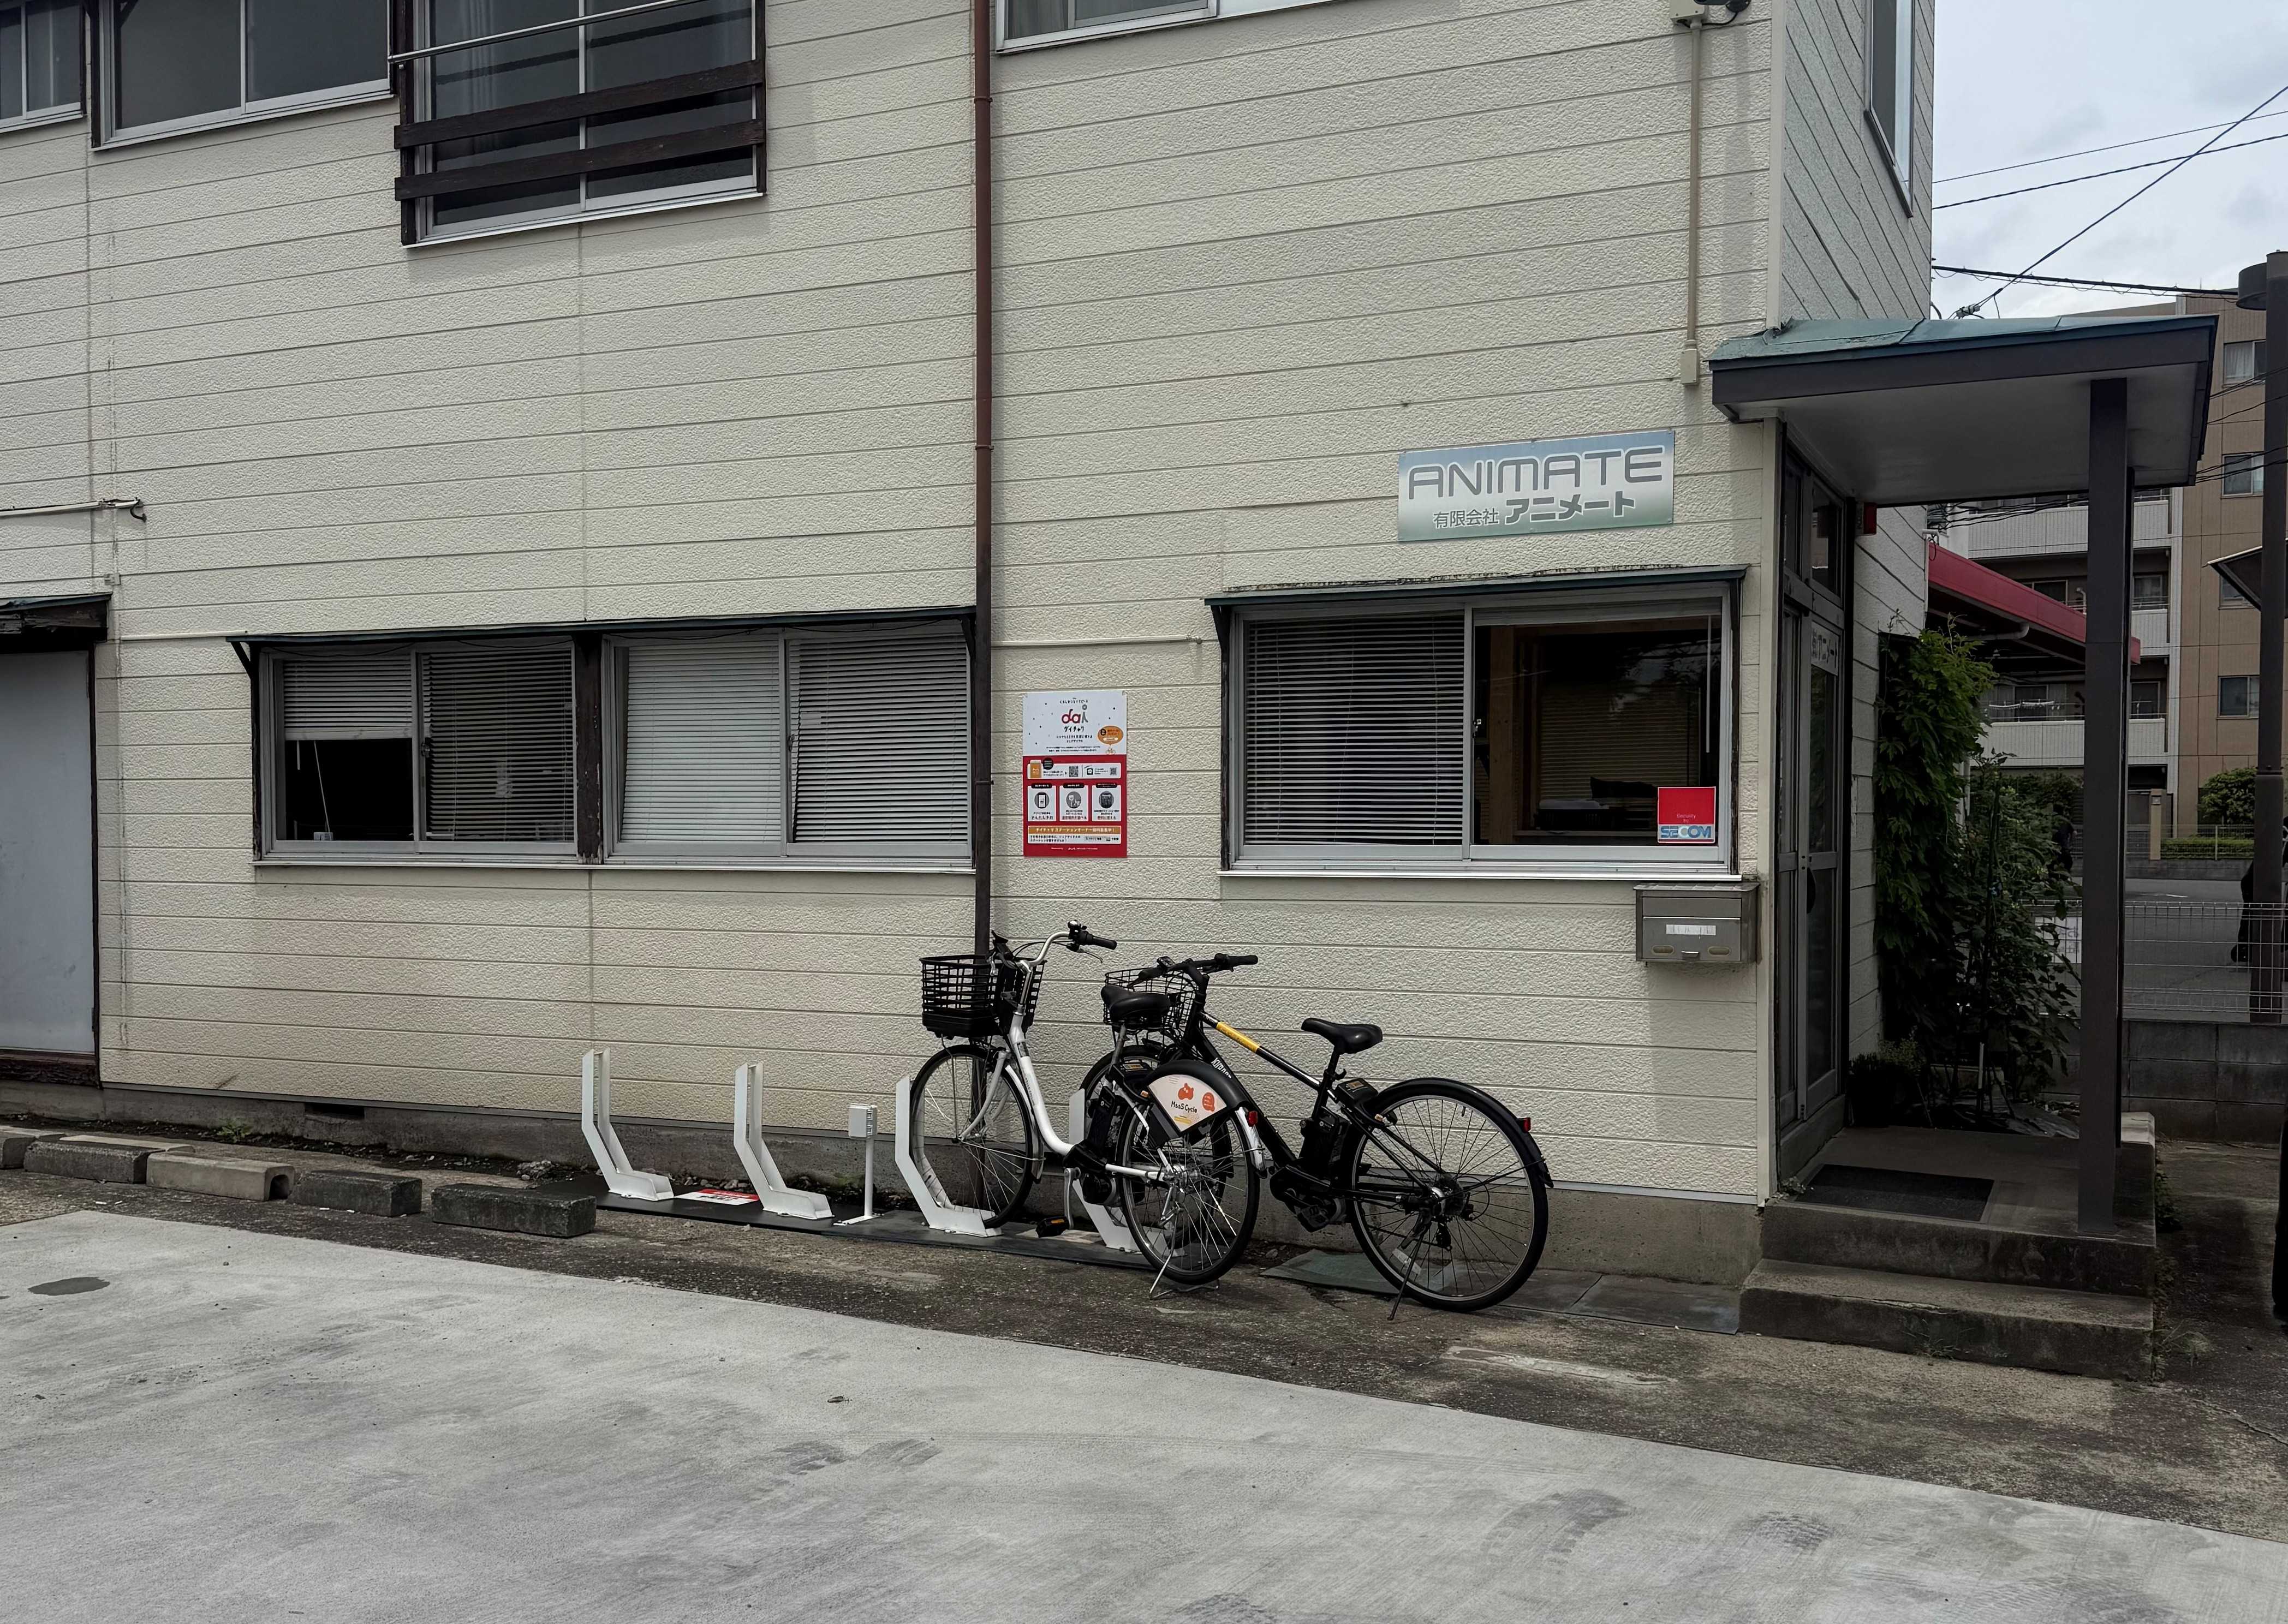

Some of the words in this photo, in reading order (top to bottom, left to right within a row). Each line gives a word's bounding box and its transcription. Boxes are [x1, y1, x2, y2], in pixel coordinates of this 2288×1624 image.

[1408, 445, 1665, 500] ANIMATE
[1433, 508, 1499, 529] 有限会社
[1505, 491, 1635, 524] アニメート
[1661, 826, 1711, 838] SECOM
[1185, 1104, 1197, 1113] Cycle
